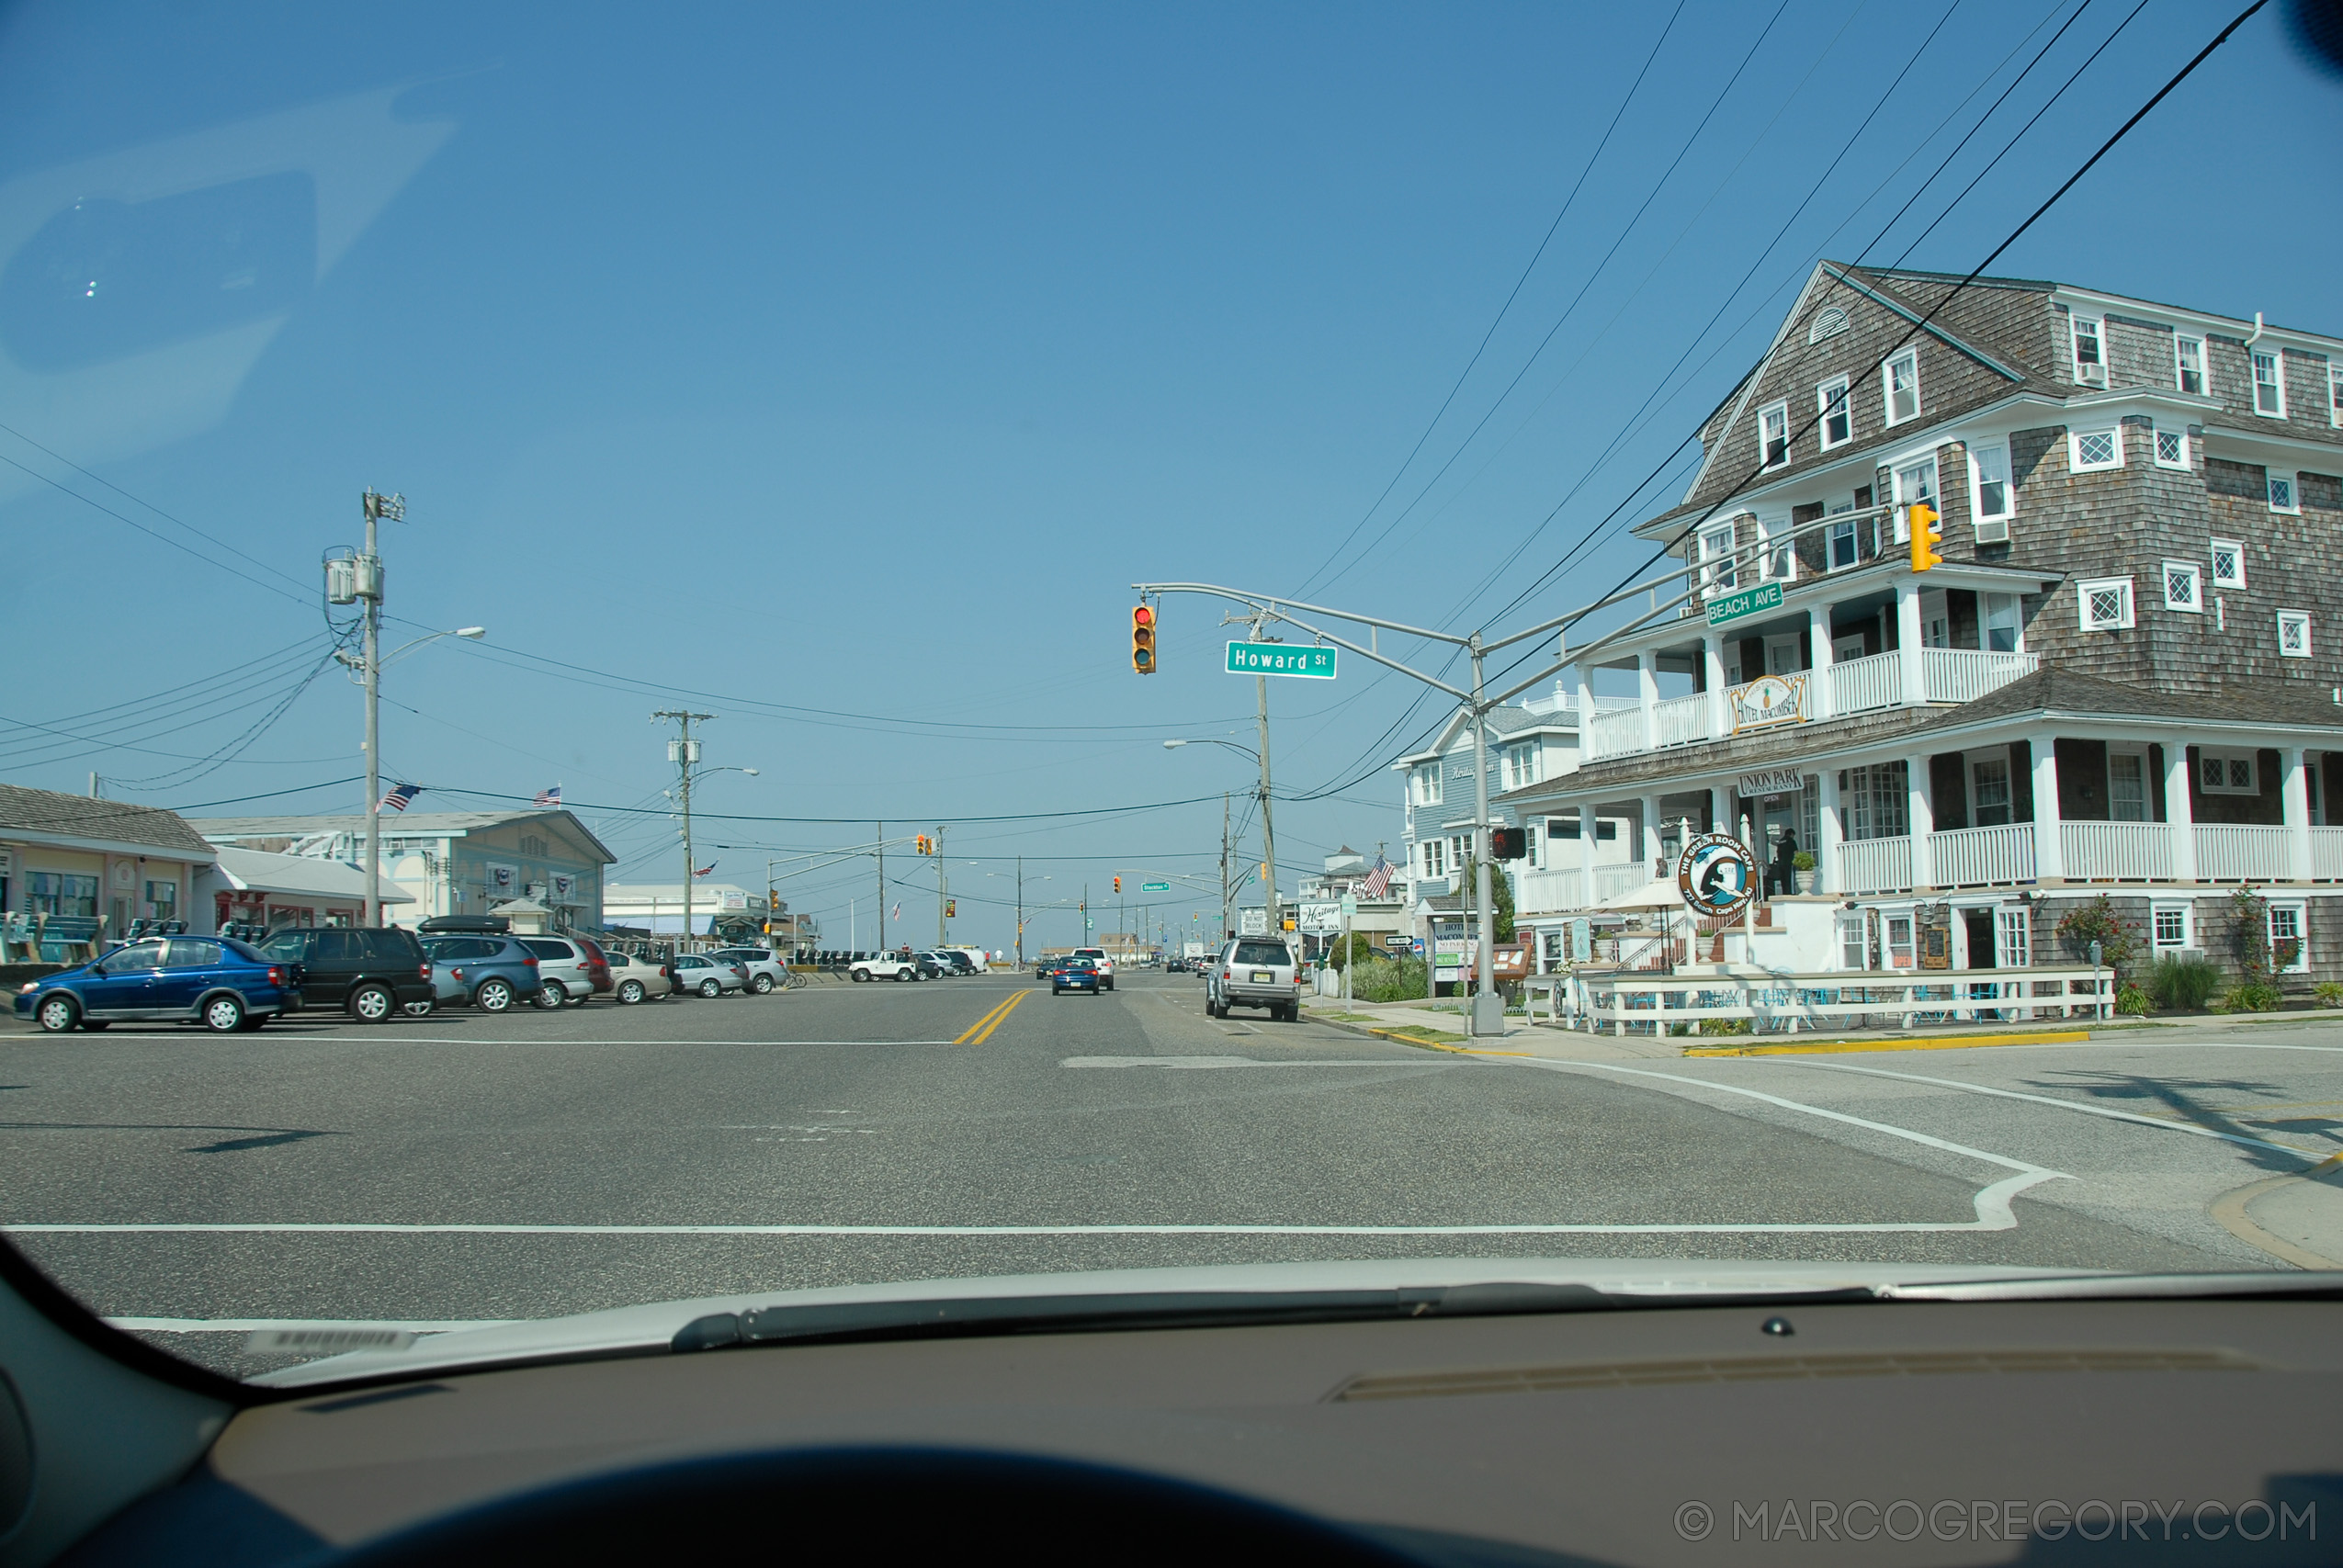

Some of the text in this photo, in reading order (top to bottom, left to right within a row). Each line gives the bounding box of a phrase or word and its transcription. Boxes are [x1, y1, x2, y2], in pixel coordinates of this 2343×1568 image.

[1708, 587, 1781, 620] BEACH AVE.
[1235, 649, 1327, 671] Howard St
[1749, 681, 1784, 699] HISTORIC
[1737, 684, 1798, 724] HOTEL MACOMBER
[1452, 765, 1476, 781] Heritag
[1739, 767, 1802, 795] UNION PARK
[1749, 783, 1793, 794] RESTAURANT
[1681, 836, 1754, 875] THE GREEN ROOM CAFE
[1683, 888, 1695, 901] 727
[1693, 900, 1713, 914] Beach
[1715, 906, 1734, 915] Cape
[1744, 886, 1753, 897] NJ
[1302, 905, 1340, 925] Heritage
[1895, 956, 1911, 966] OPEN
